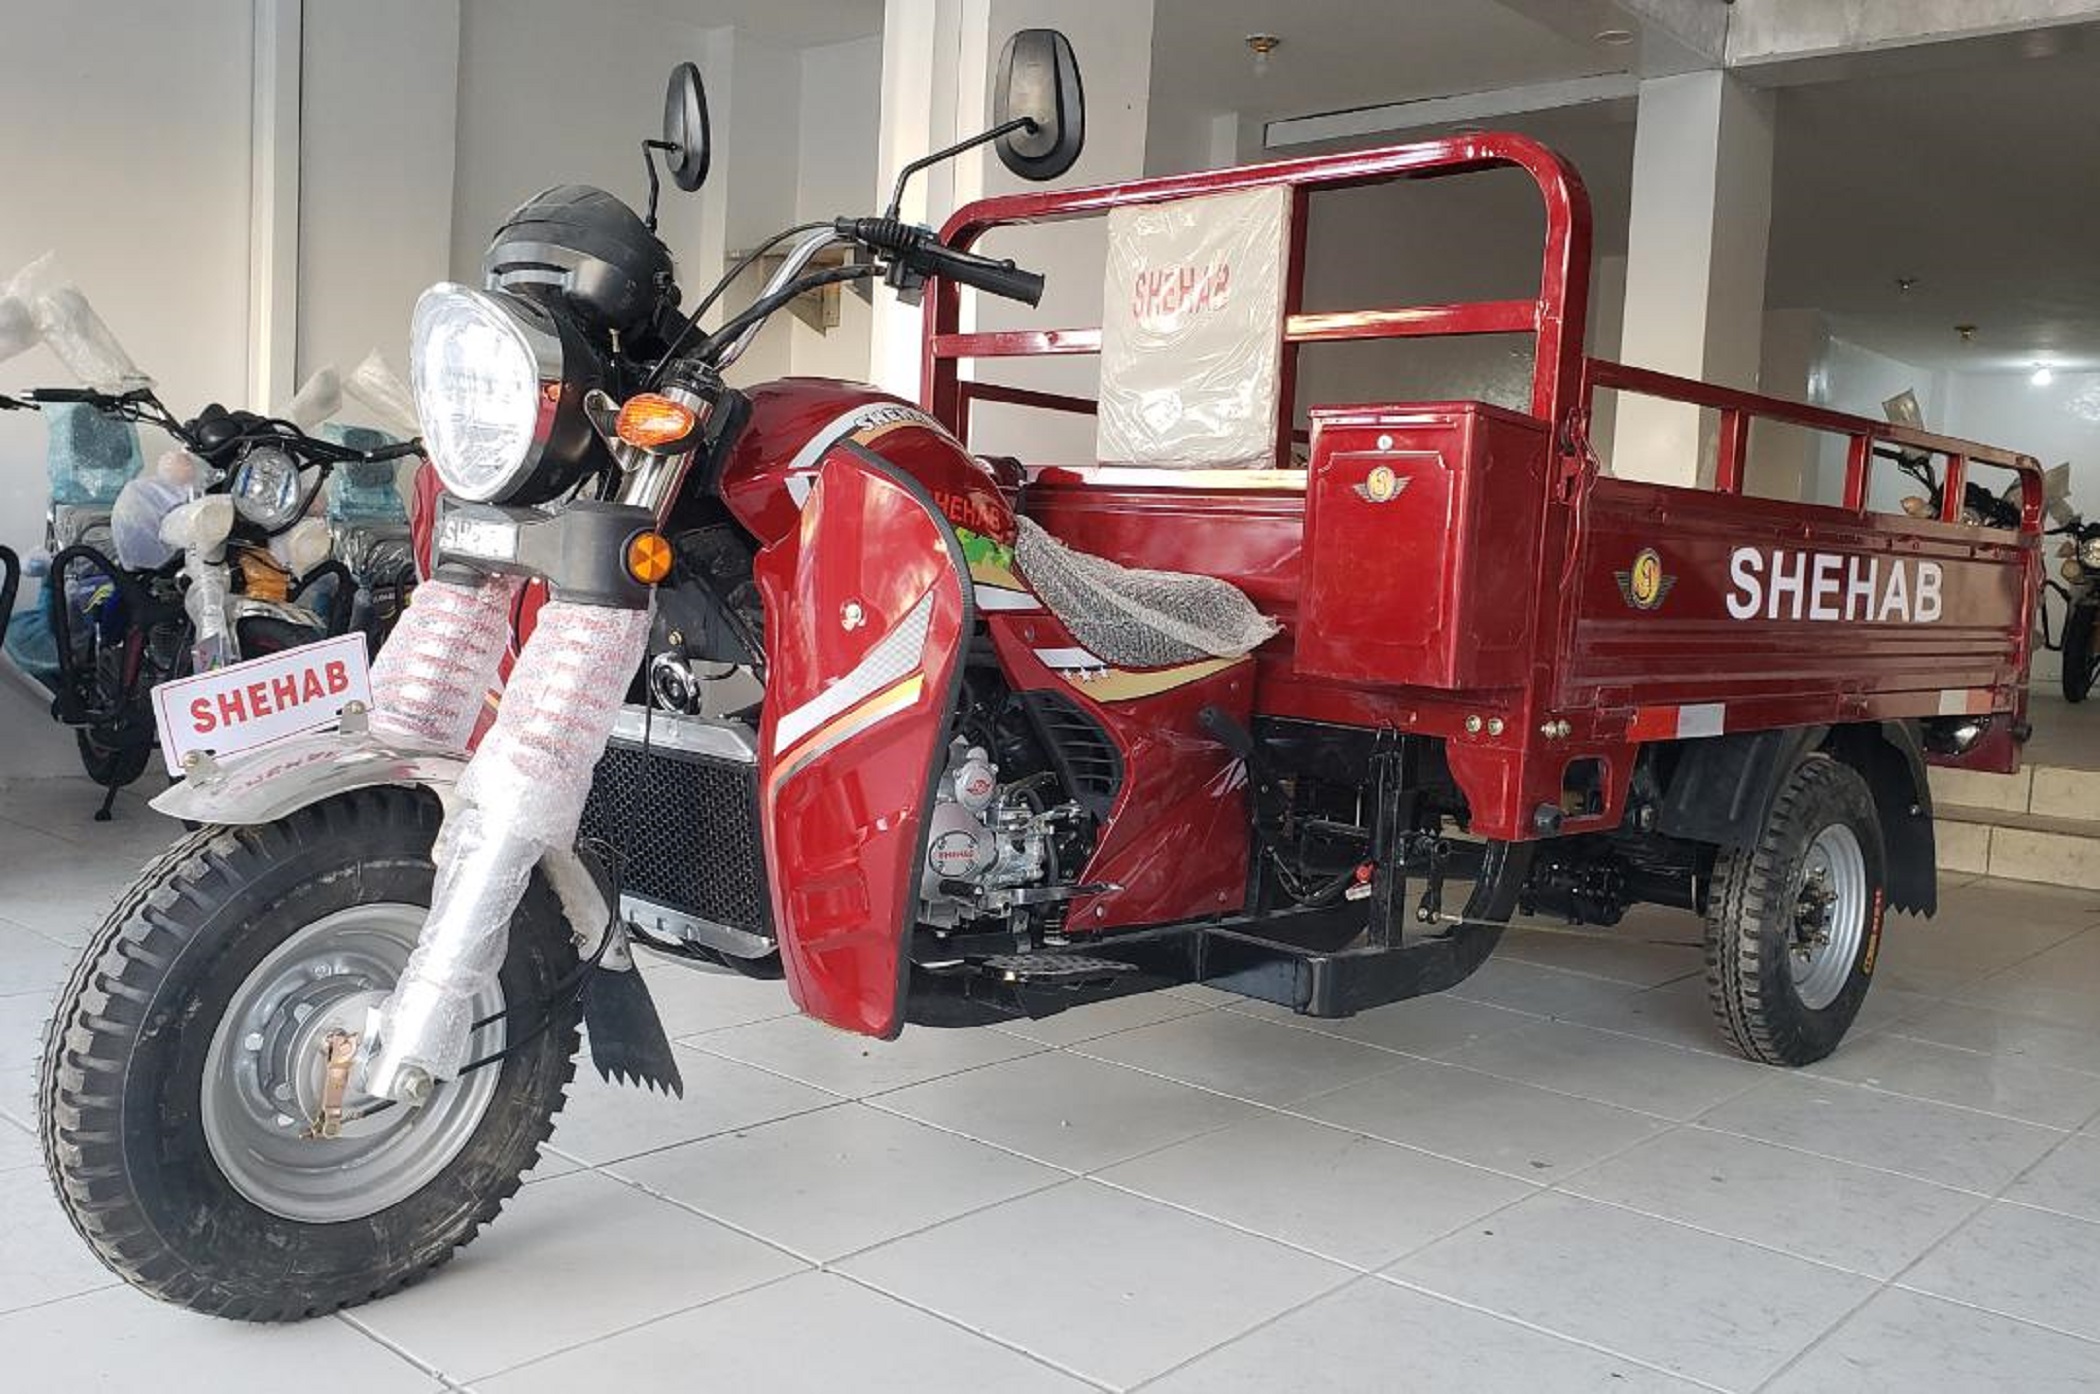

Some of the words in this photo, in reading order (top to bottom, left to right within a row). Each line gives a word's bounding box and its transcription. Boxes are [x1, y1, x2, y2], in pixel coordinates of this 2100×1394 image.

[933, 489, 1001, 533] HEHAB
[1726, 546, 1943, 623] SHEHAB
[190, 660, 350, 734] SHEHAB
